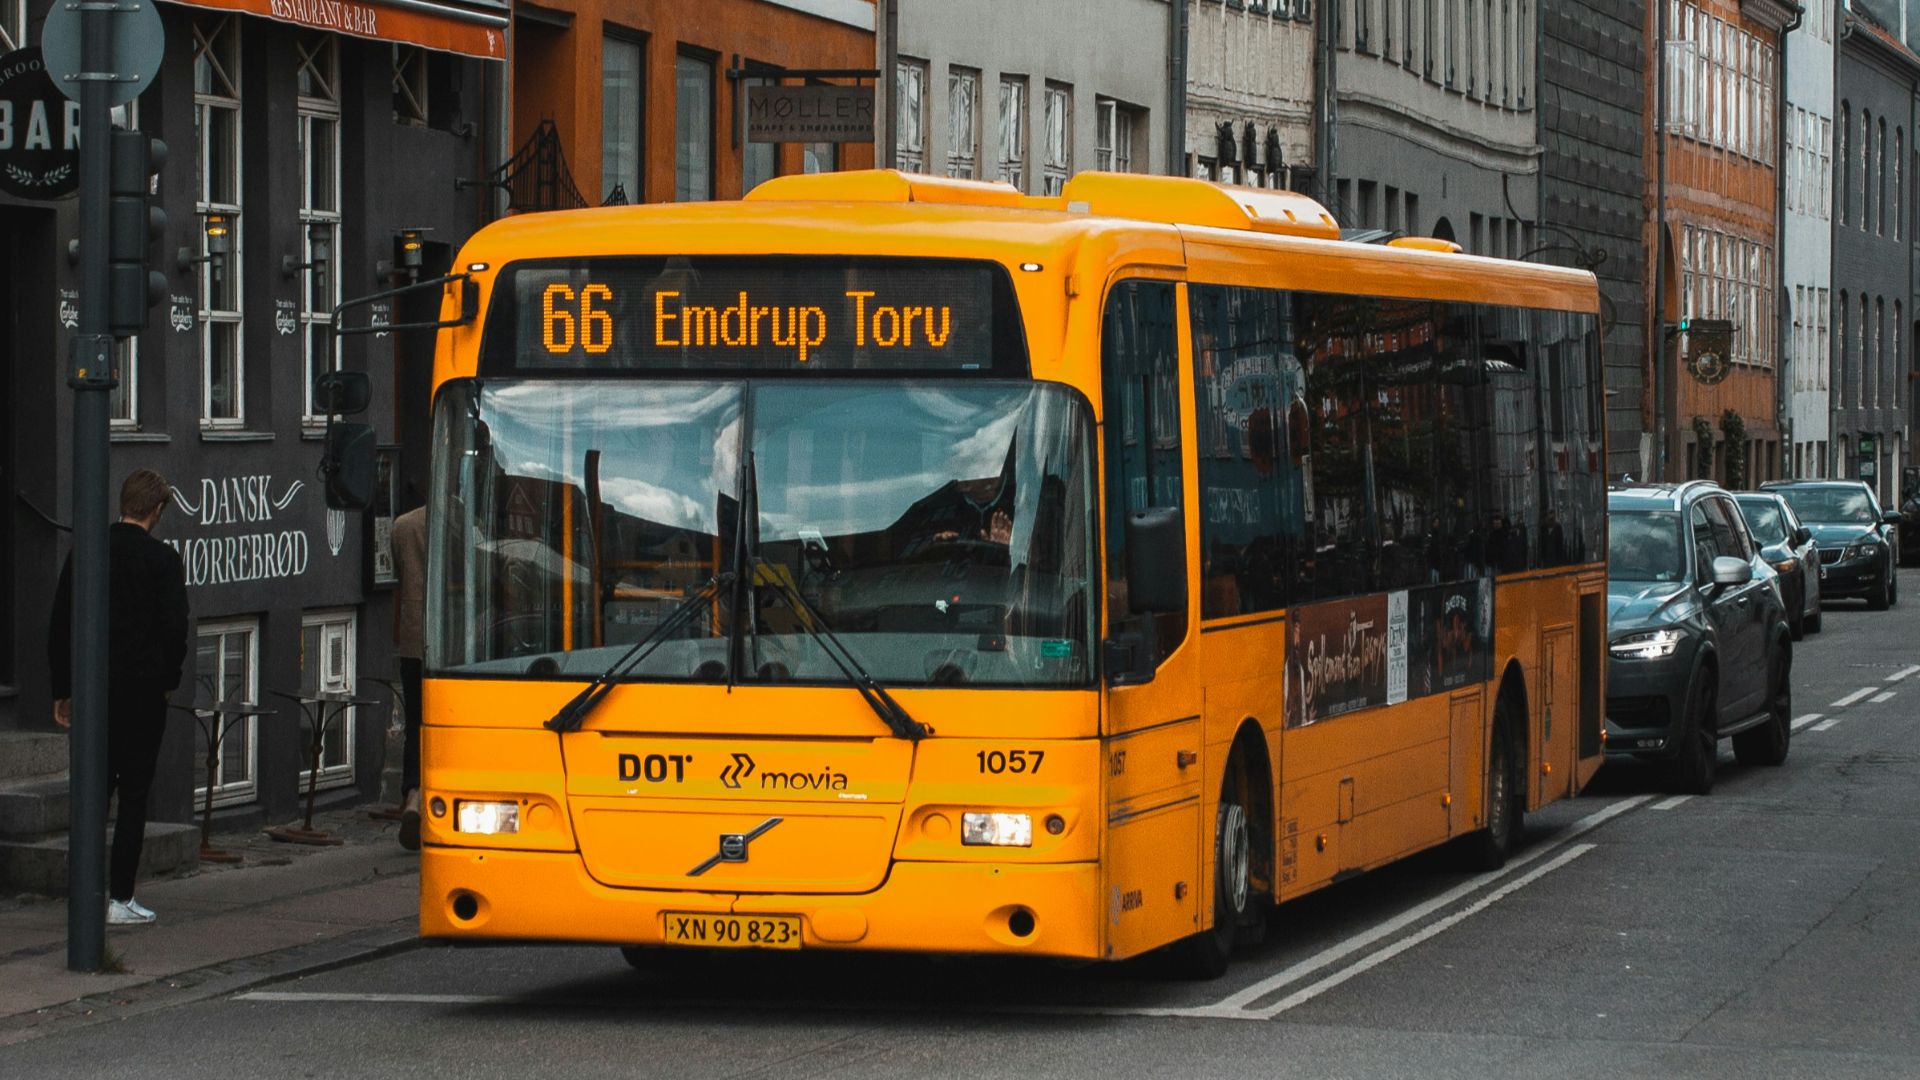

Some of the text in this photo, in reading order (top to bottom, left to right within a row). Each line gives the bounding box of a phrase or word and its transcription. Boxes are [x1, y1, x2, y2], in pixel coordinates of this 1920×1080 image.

[270, 0, 377, 35] RESTAURANT & BAR
[749, 95, 872, 119] MØLLER
[0, 99, 80, 151] BAR
[170, 305, 193, 333] Carlsberg
[275, 310, 296, 337] Carlsberg
[542, 284, 951, 361] 66 Emdrup Torv
[200, 475, 273, 526] DANSK
[163, 530, 309, 586] MØRREBRØD
[618, 753, 693, 783] DOT
[976, 750, 1045, 774] 1057
[1109, 751, 1126, 776] 1057
[760, 766, 849, 790] movia
[676, 918, 790, 944] XN 90 823
